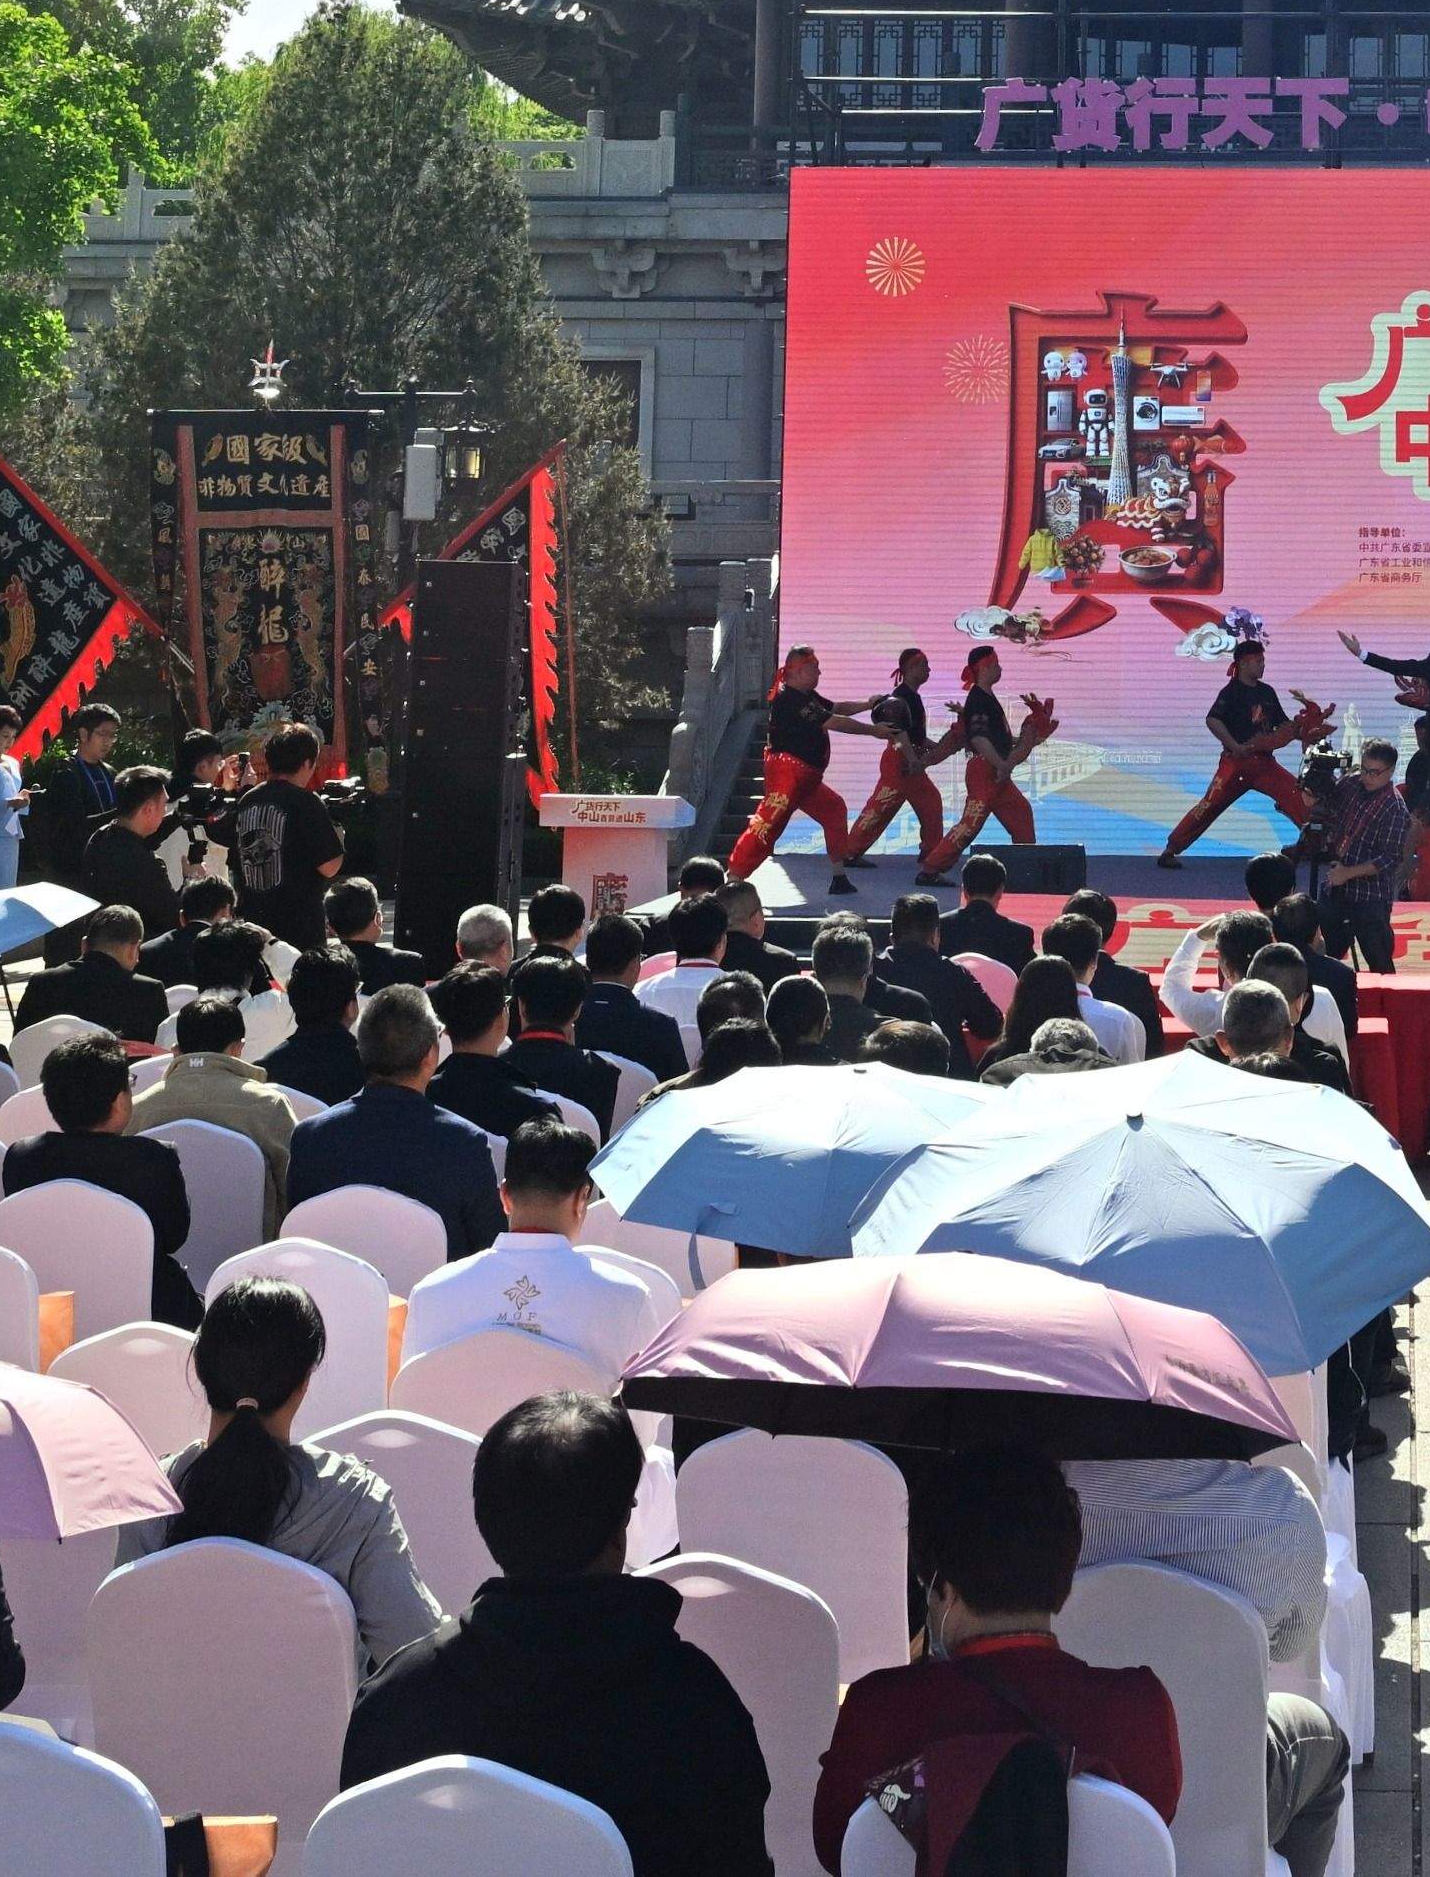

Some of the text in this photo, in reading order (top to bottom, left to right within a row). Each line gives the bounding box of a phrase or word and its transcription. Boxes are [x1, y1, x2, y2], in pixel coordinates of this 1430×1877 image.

[1358, 572, 1423, 583] 广东省商务厅
